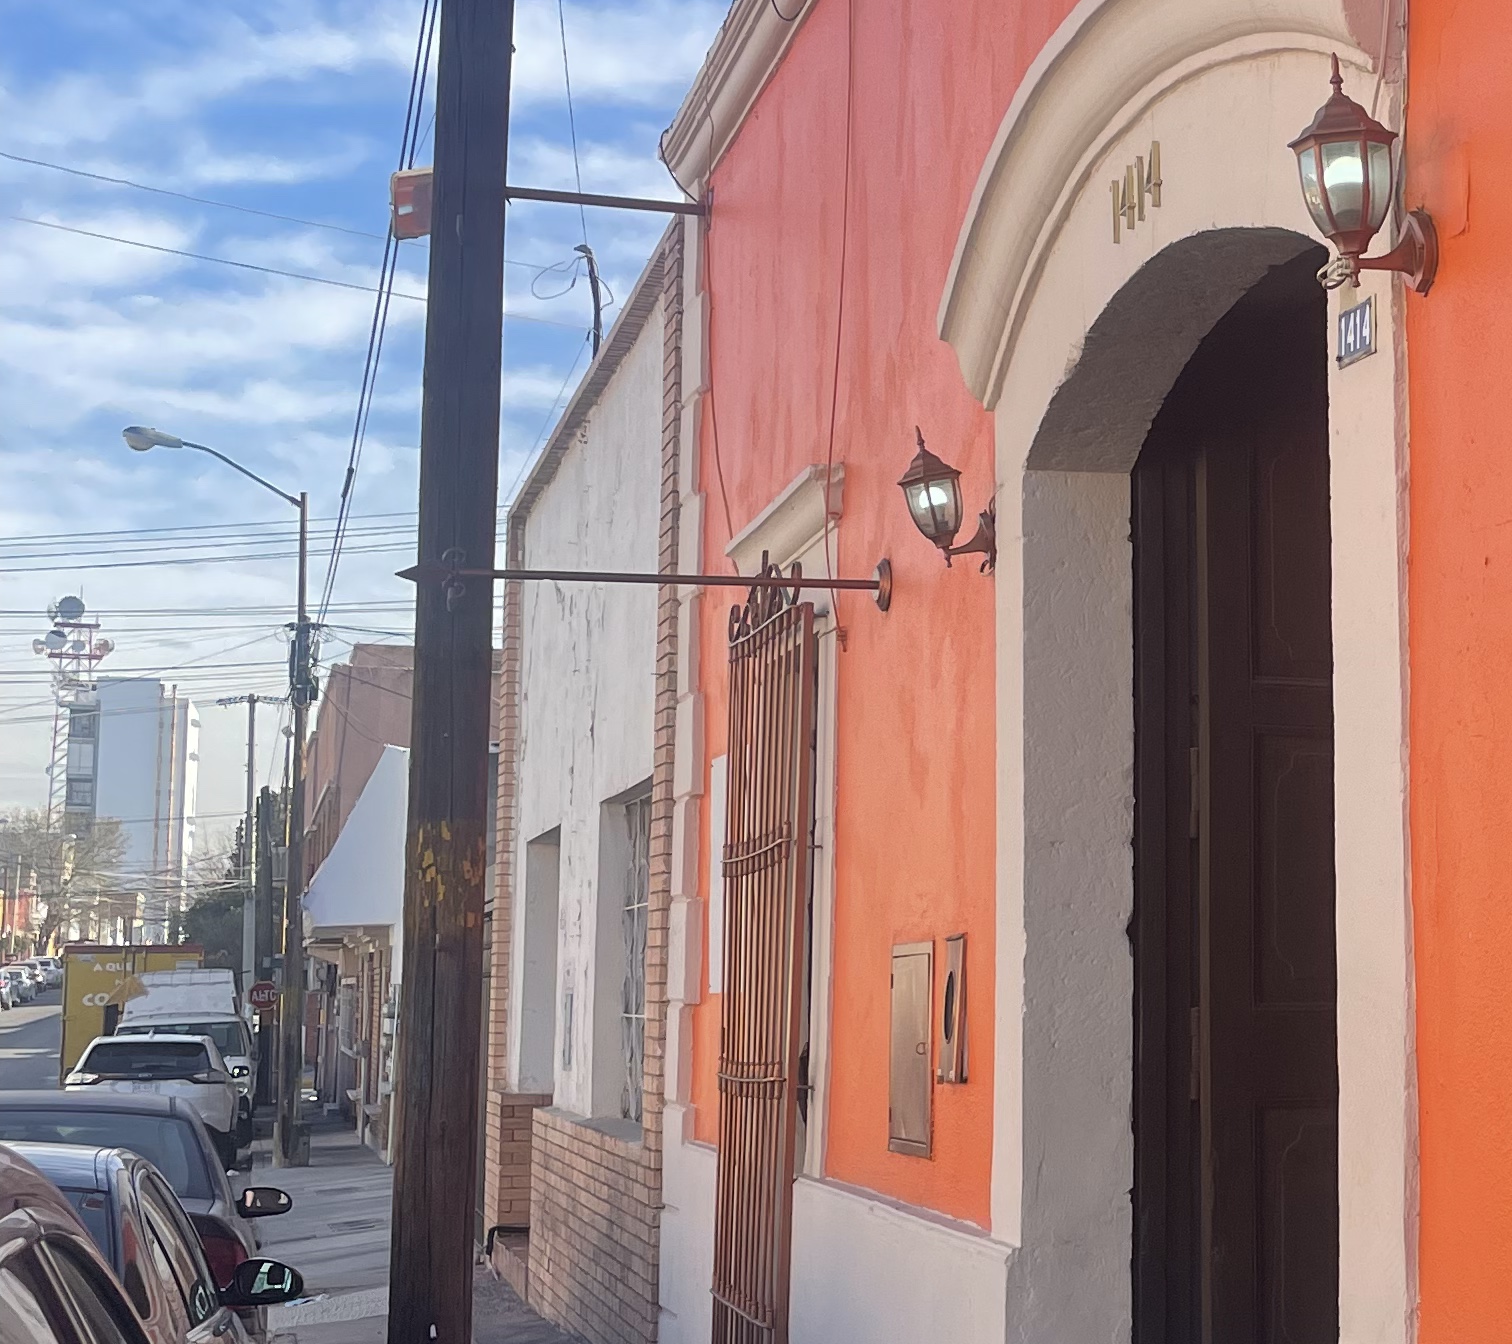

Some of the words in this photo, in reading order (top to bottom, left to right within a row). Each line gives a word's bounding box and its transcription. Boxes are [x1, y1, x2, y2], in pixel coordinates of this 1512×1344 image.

[1109, 140, 1162, 245] 1414
[1341, 303, 1370, 356] 1414
[251, 989, 278, 1003] ALTO
